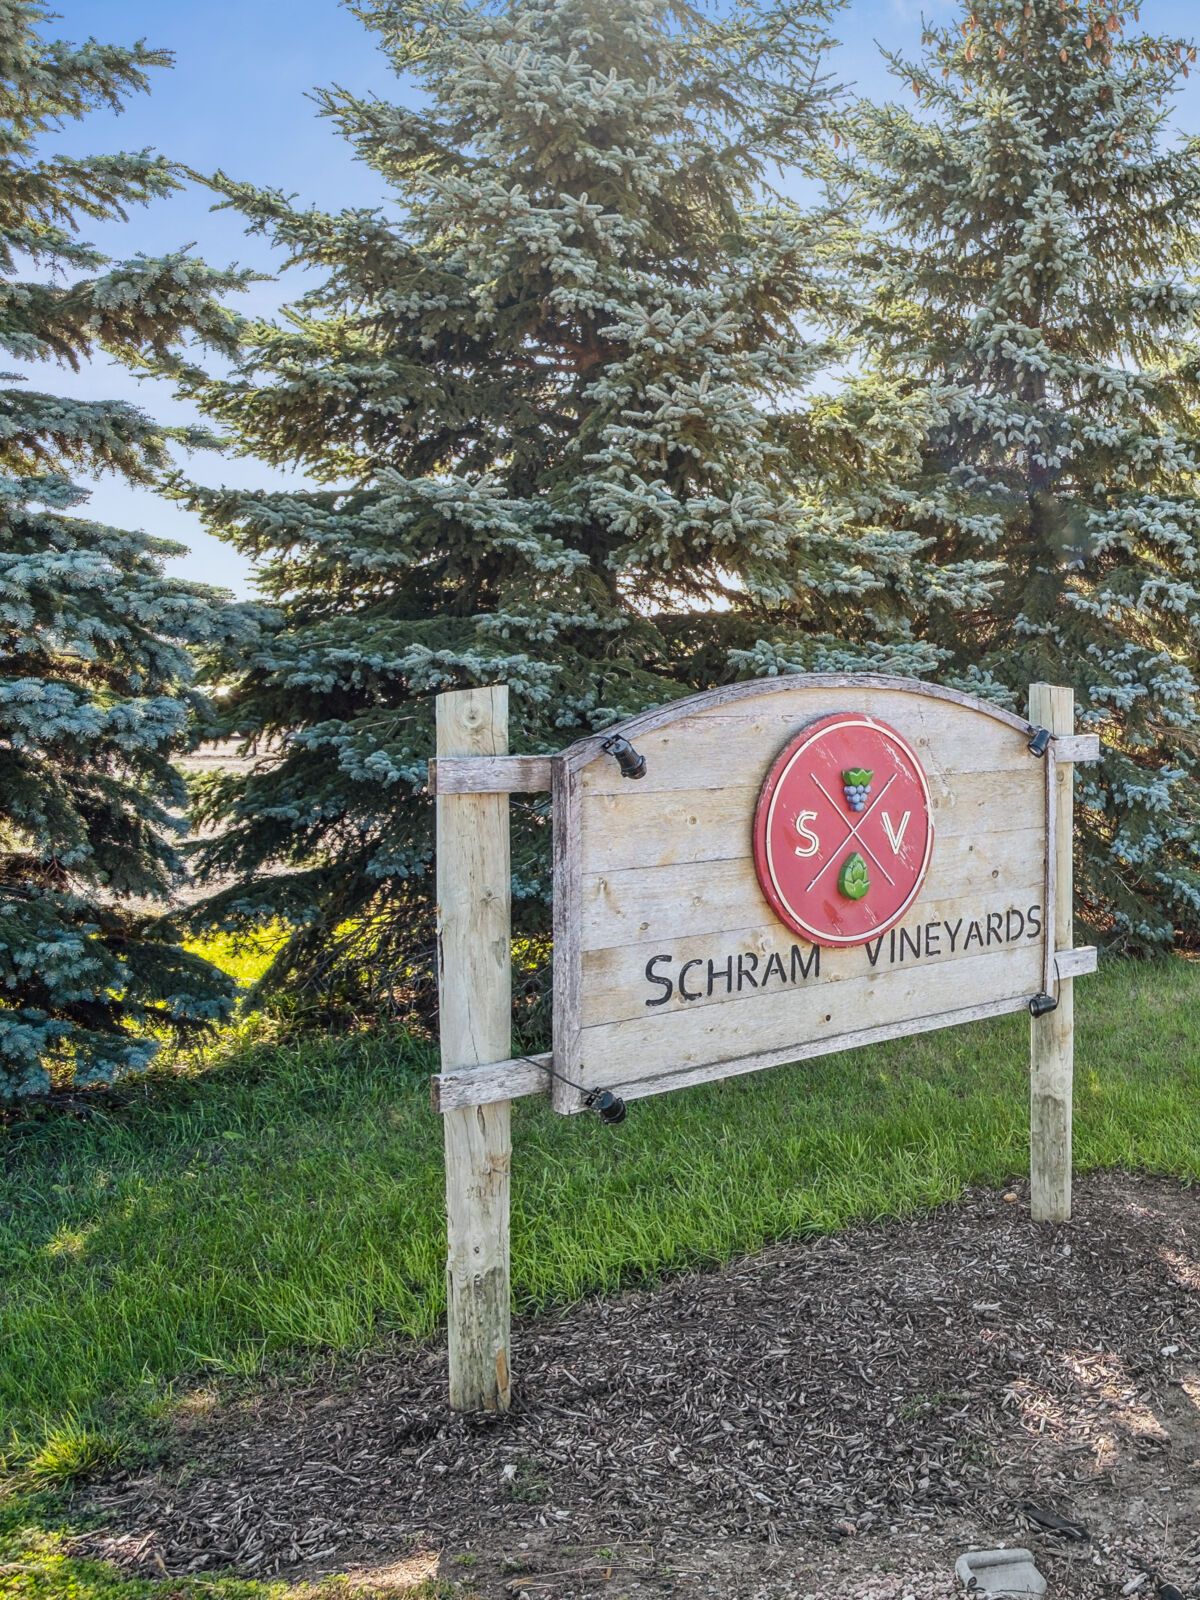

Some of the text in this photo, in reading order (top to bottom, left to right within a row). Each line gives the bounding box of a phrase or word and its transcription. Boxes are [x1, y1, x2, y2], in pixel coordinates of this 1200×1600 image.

[794, 810, 911, 858] S V
[644, 904, 1042, 1007] SCHRAM VINEYARDS
